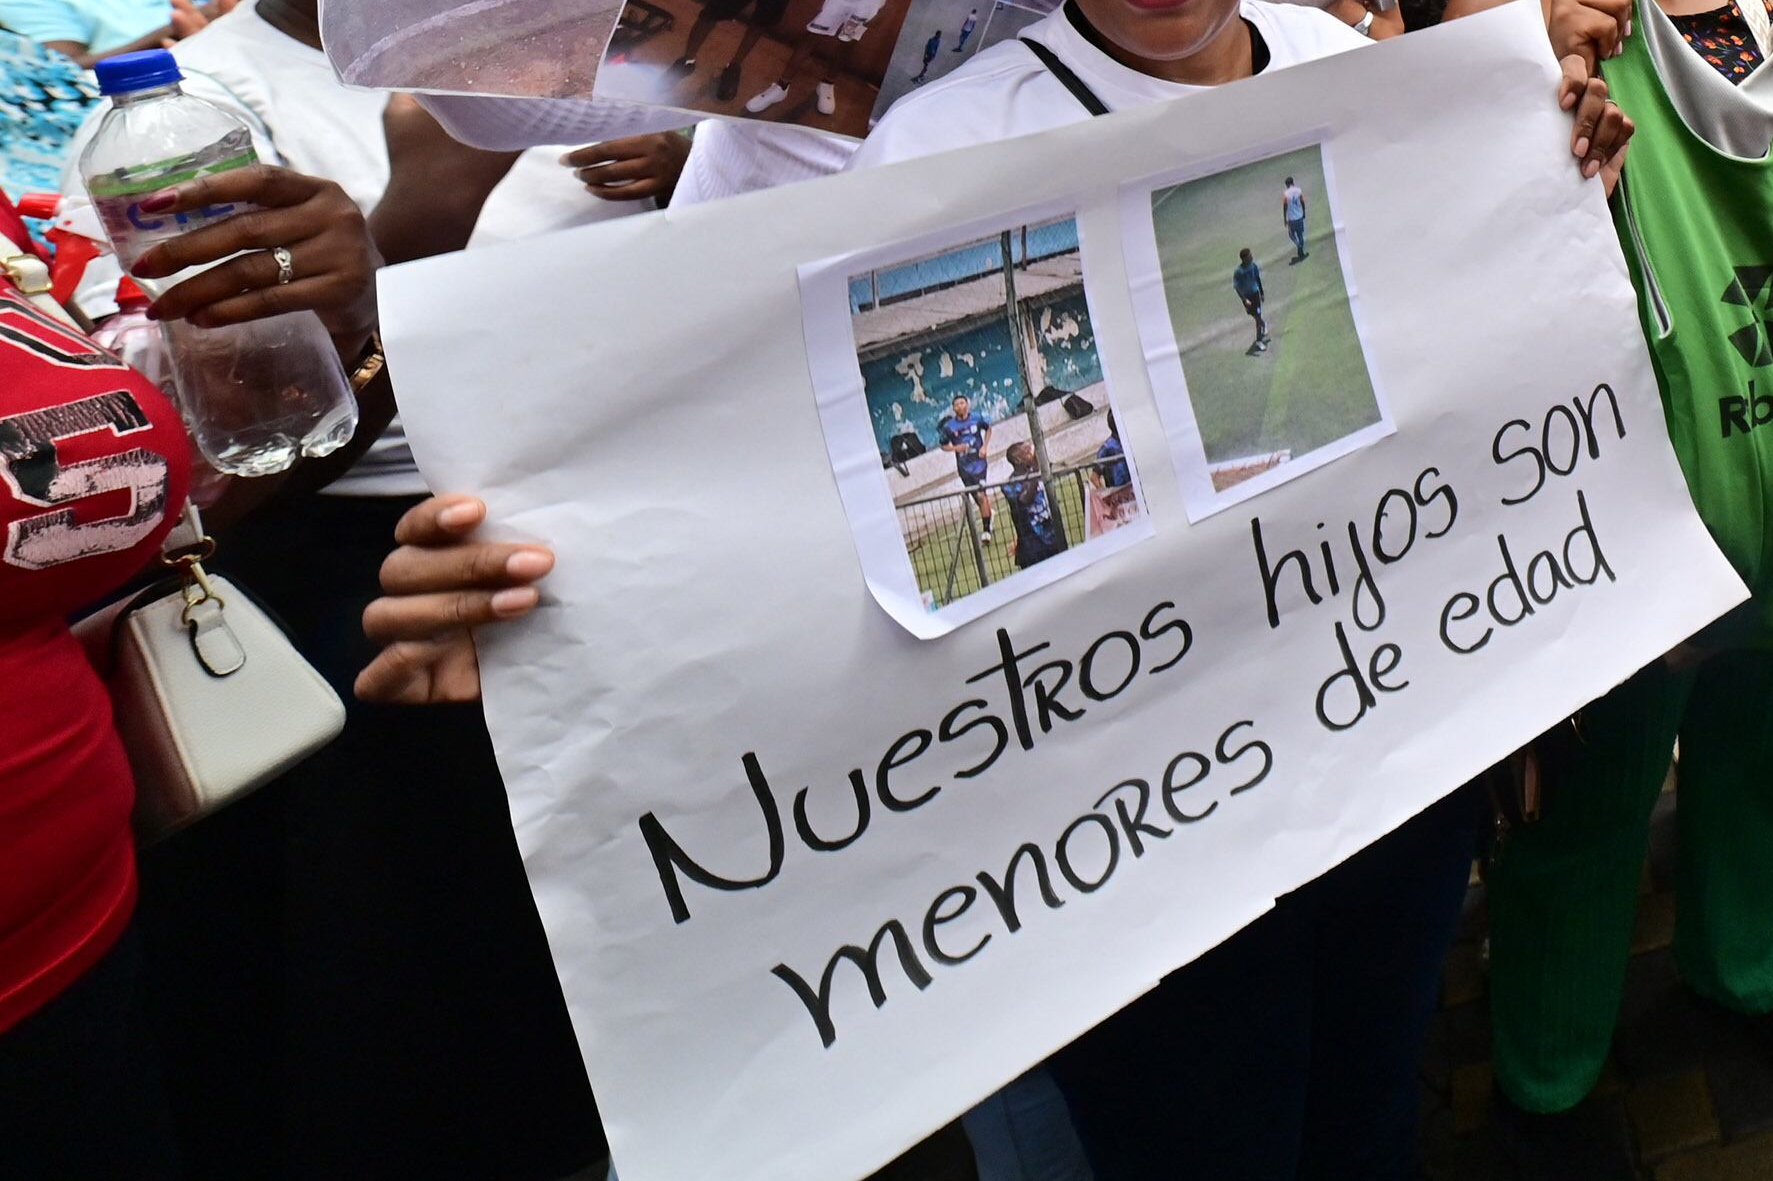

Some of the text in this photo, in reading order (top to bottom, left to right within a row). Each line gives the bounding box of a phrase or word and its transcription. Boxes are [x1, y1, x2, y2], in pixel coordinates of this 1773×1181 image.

[1251, 466, 1459, 632] hijos
[1491, 383, 1626, 506] son
[1315, 620, 1411, 733] de
[1439, 490, 1616, 655] edad
